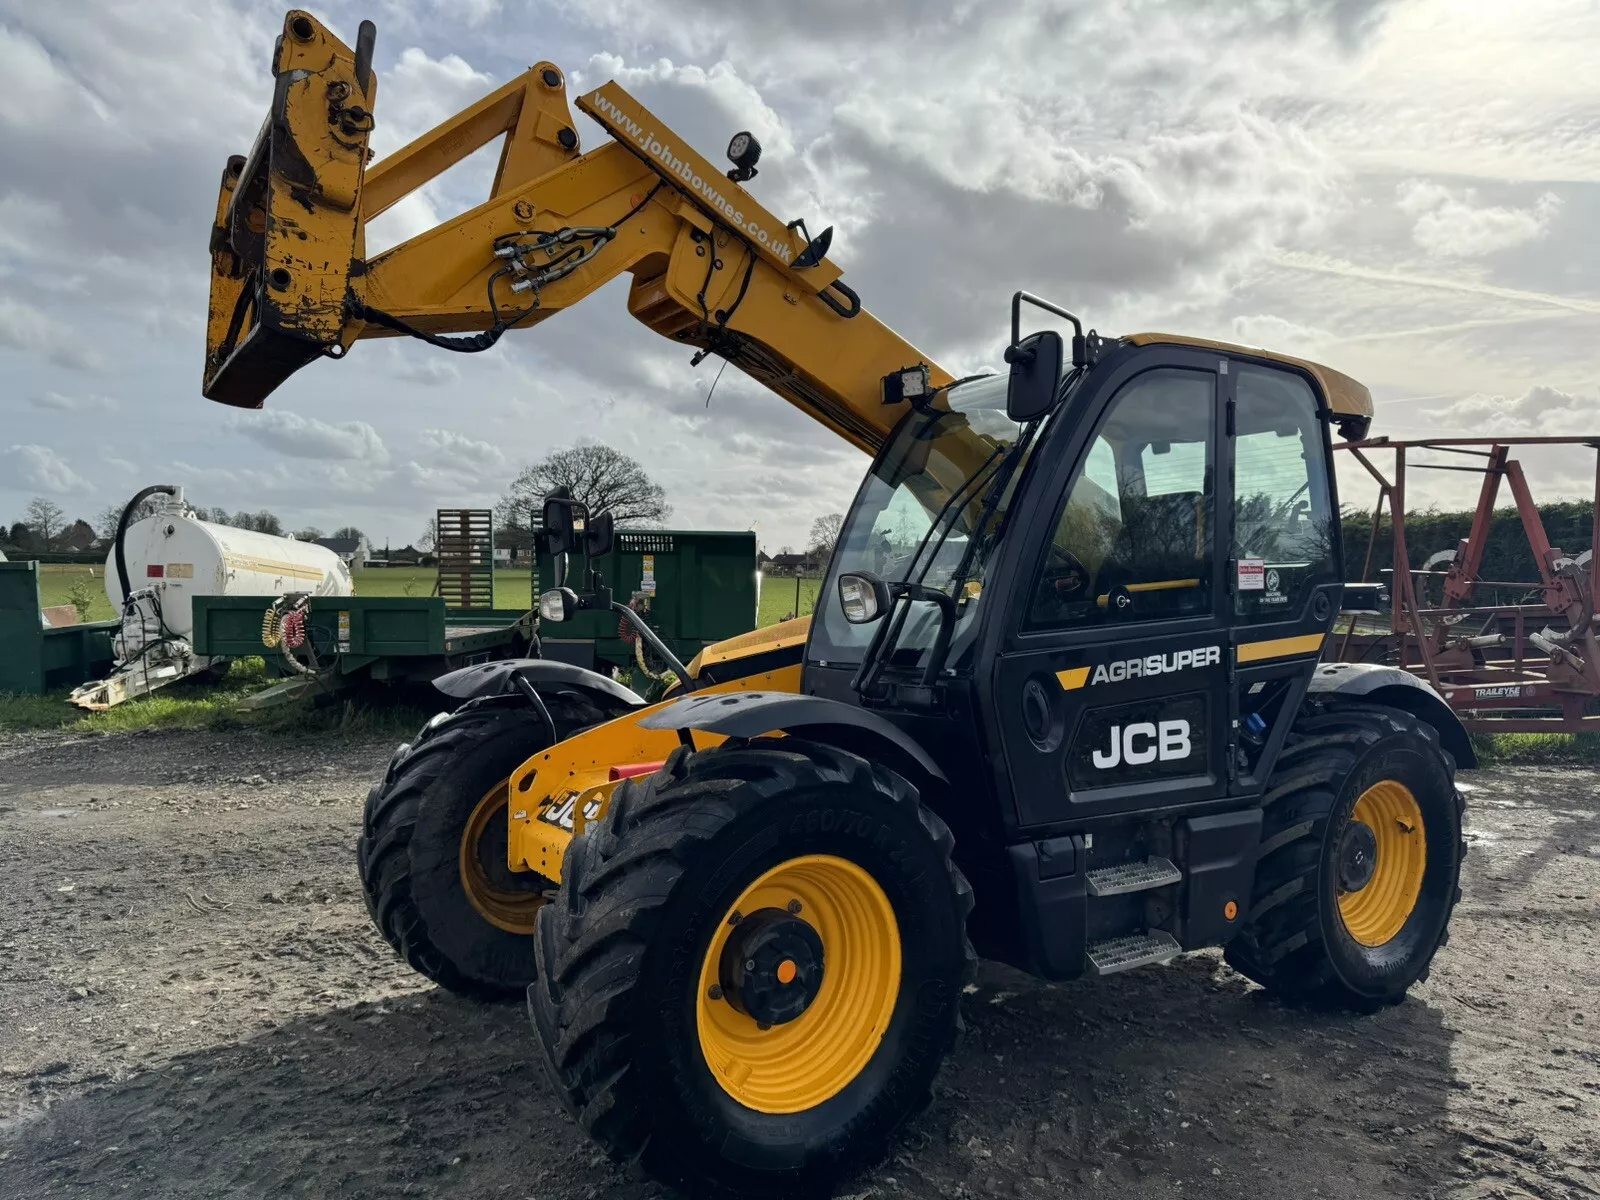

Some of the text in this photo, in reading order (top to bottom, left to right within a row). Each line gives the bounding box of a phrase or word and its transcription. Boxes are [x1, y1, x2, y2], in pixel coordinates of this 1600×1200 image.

[593, 92, 792, 262] www.johnbownes.co.uk
[1091, 645, 1221, 686] AGRISUPER
[1092, 719, 1192, 769] JCB
